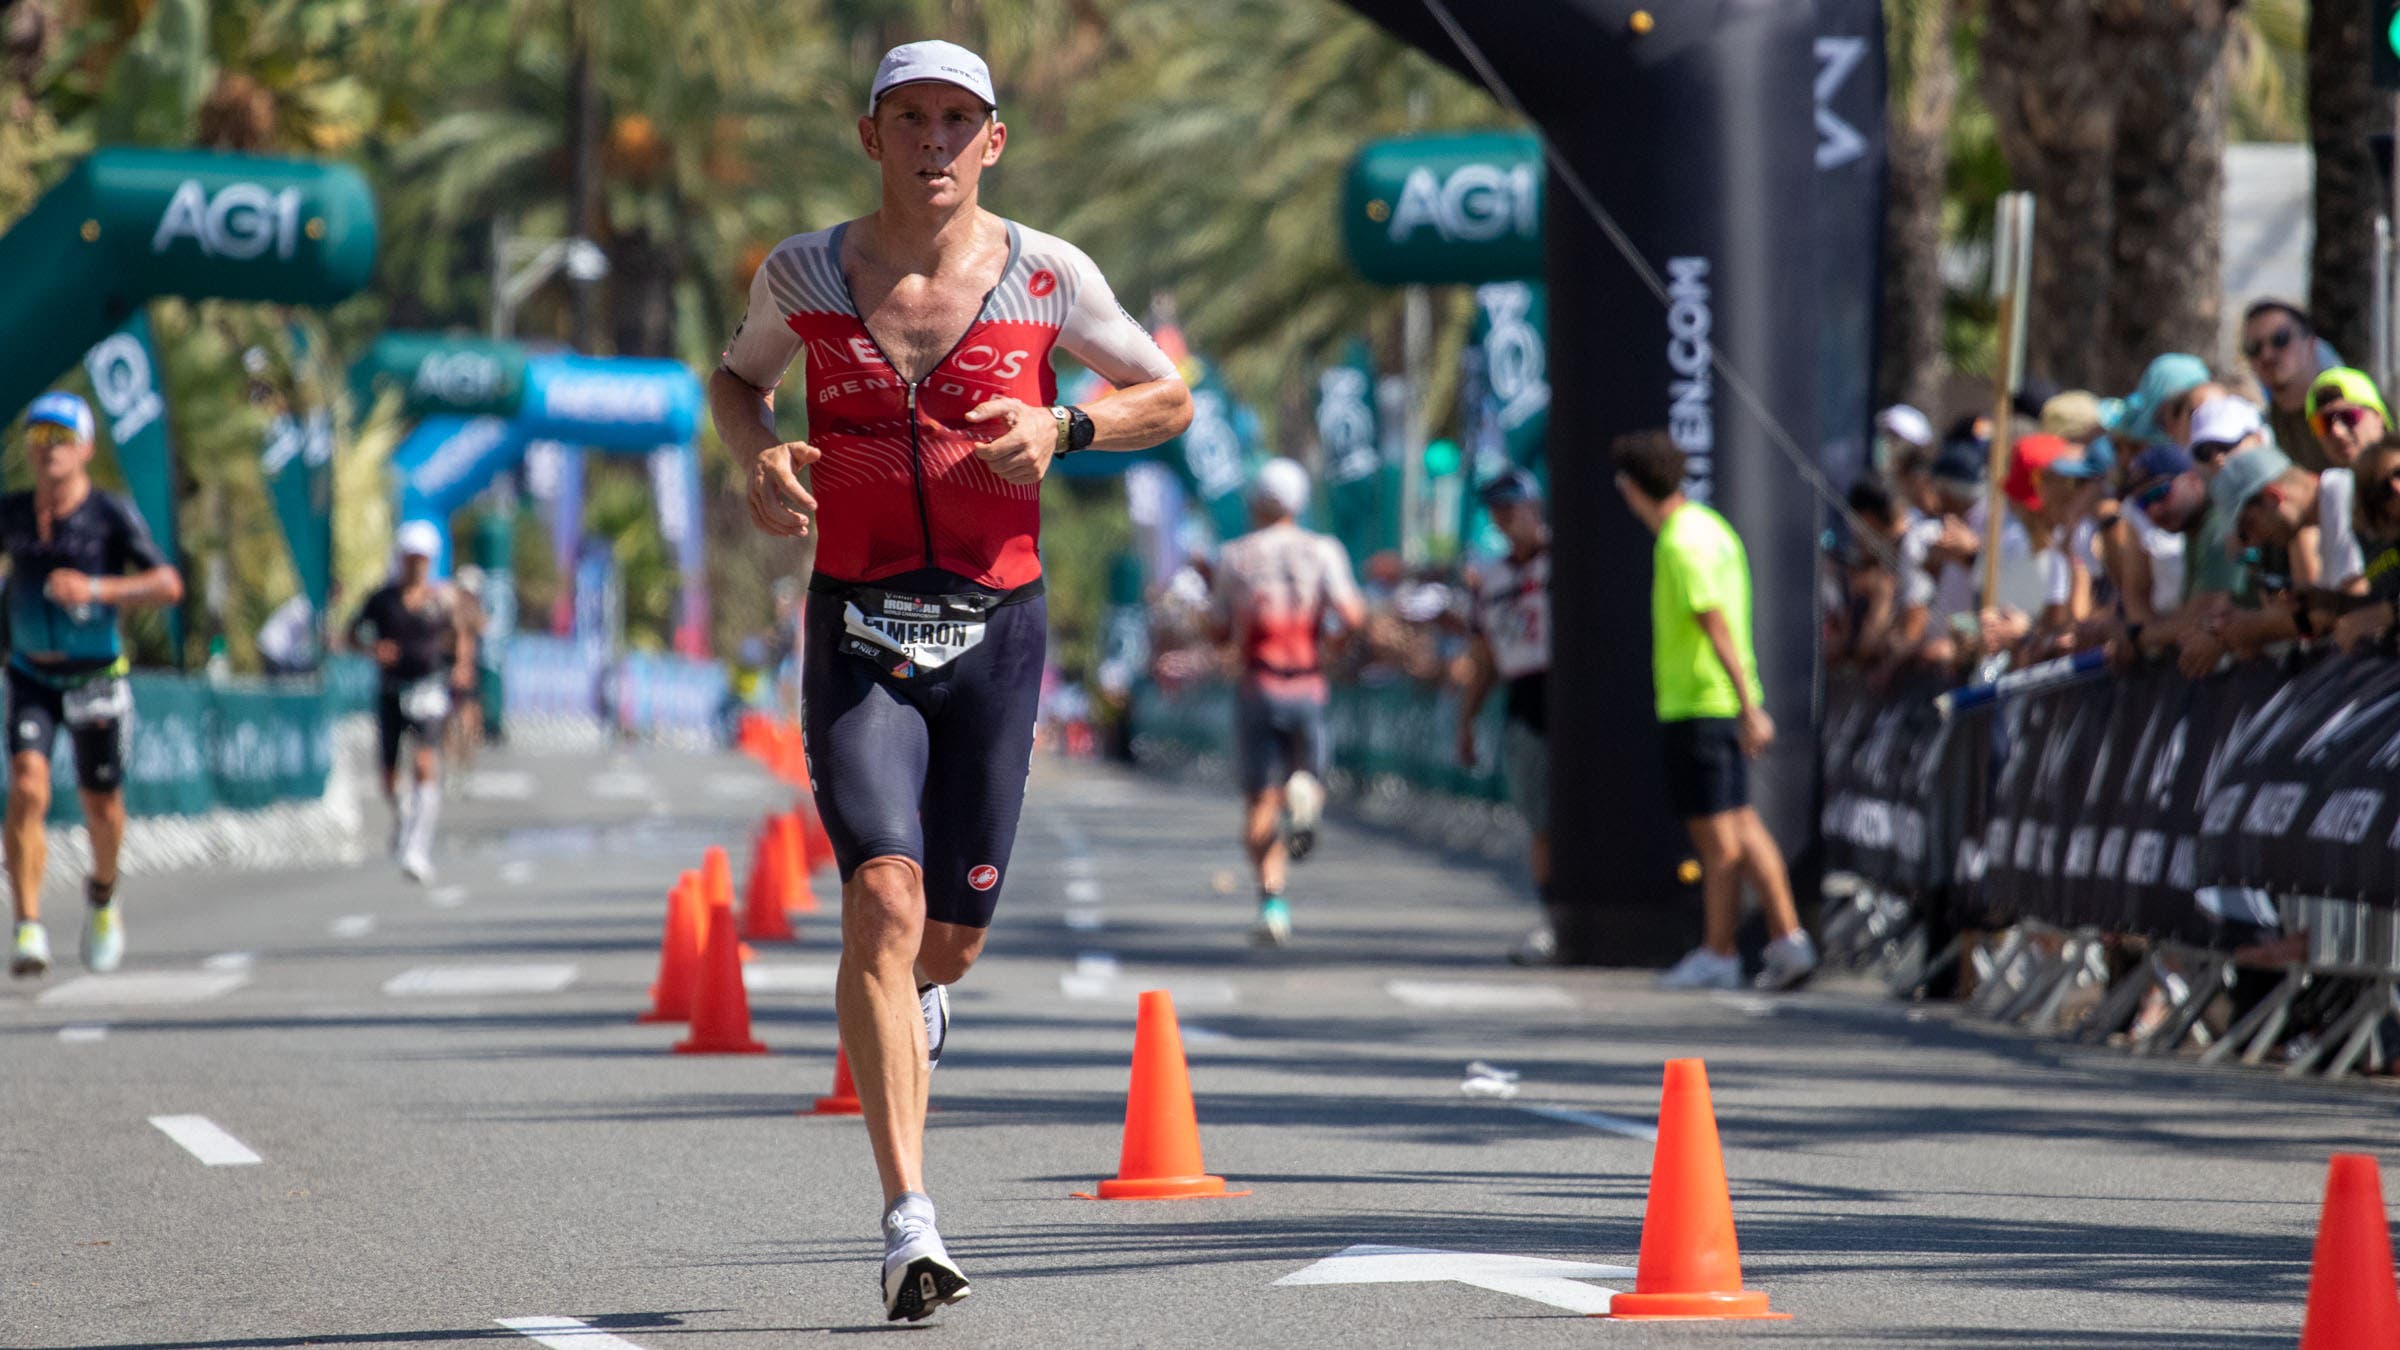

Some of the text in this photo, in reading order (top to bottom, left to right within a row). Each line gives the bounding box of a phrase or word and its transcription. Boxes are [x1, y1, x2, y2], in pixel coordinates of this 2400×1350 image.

[152, 179, 303, 260] AG1
[1388, 163, 1538, 243] AG1
[809, 336, 1029, 379] INEOS
